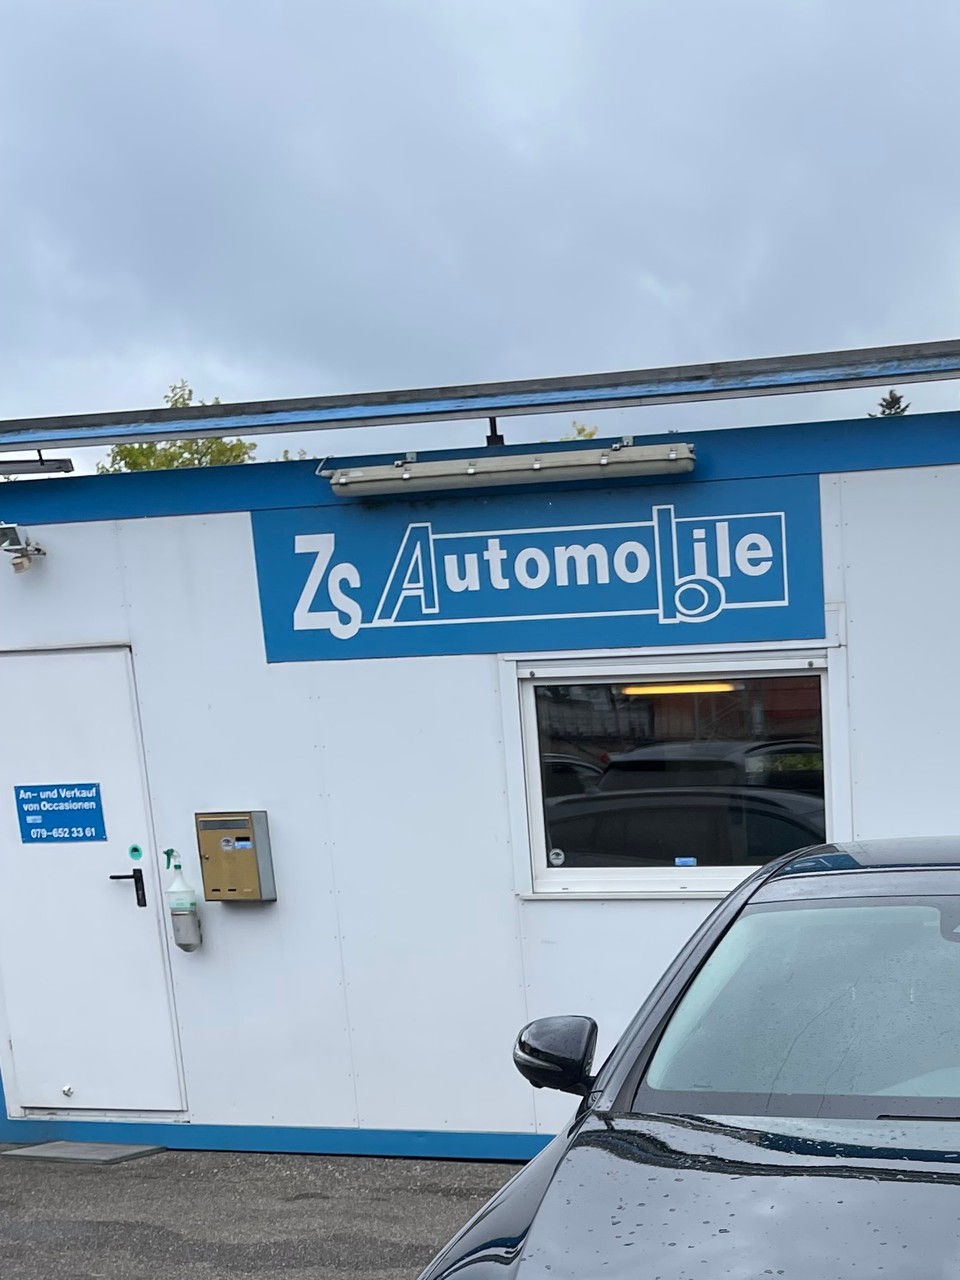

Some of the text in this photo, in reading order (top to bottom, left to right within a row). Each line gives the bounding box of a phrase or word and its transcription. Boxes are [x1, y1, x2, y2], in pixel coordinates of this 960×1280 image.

[371, 504, 774, 625] Automobile
[40, 788, 58, 799] und
[59, 787, 97, 798] Verkauf
[22, 800, 96, 811] von Occasionen
[30, 827, 96, 838] 079-652 33 61
